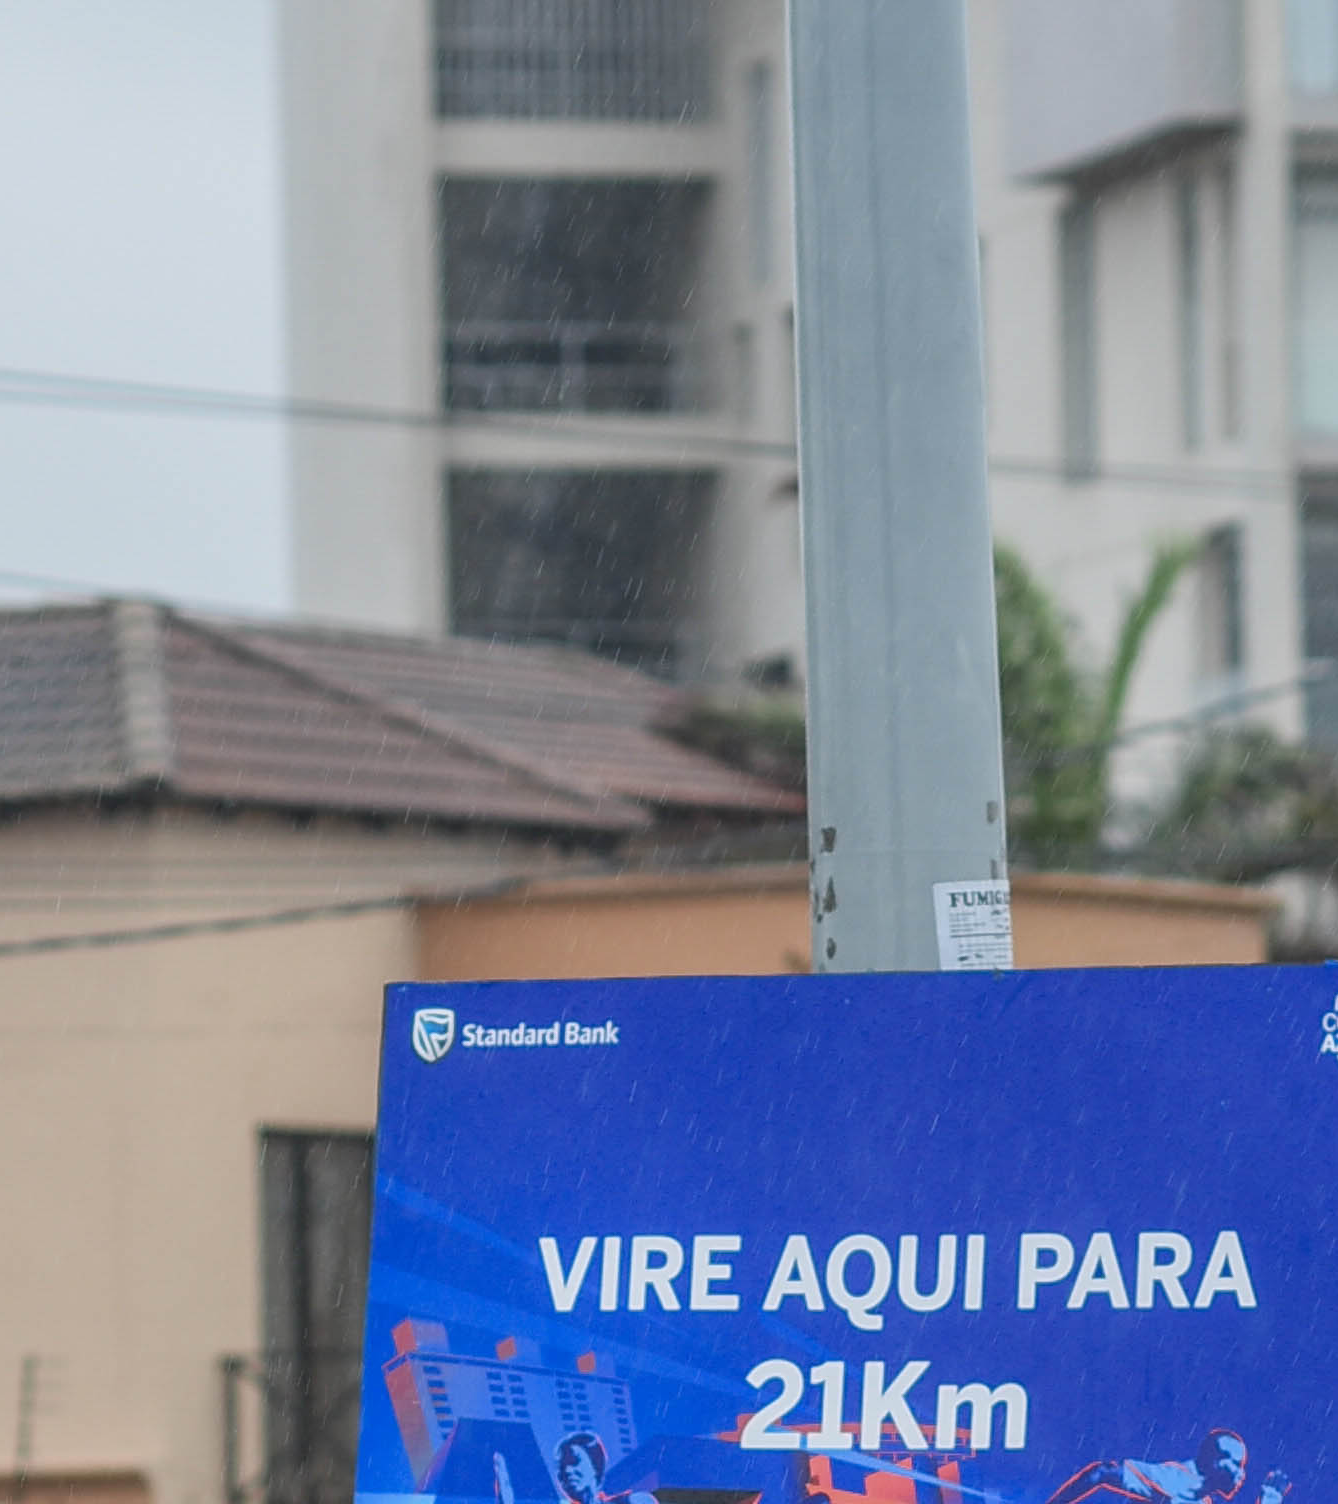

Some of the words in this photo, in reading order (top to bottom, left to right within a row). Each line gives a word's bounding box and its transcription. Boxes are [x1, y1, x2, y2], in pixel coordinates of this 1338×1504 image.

[462, 1021, 560, 1047] Standard
[564, 1020, 619, 1045] Bank
[538, 1235, 742, 1313] VIRE
[762, 1234, 986, 1331] AQUI
[1017, 1231, 1257, 1310] PARA
[740, 1360, 1028, 1451] 21Km
